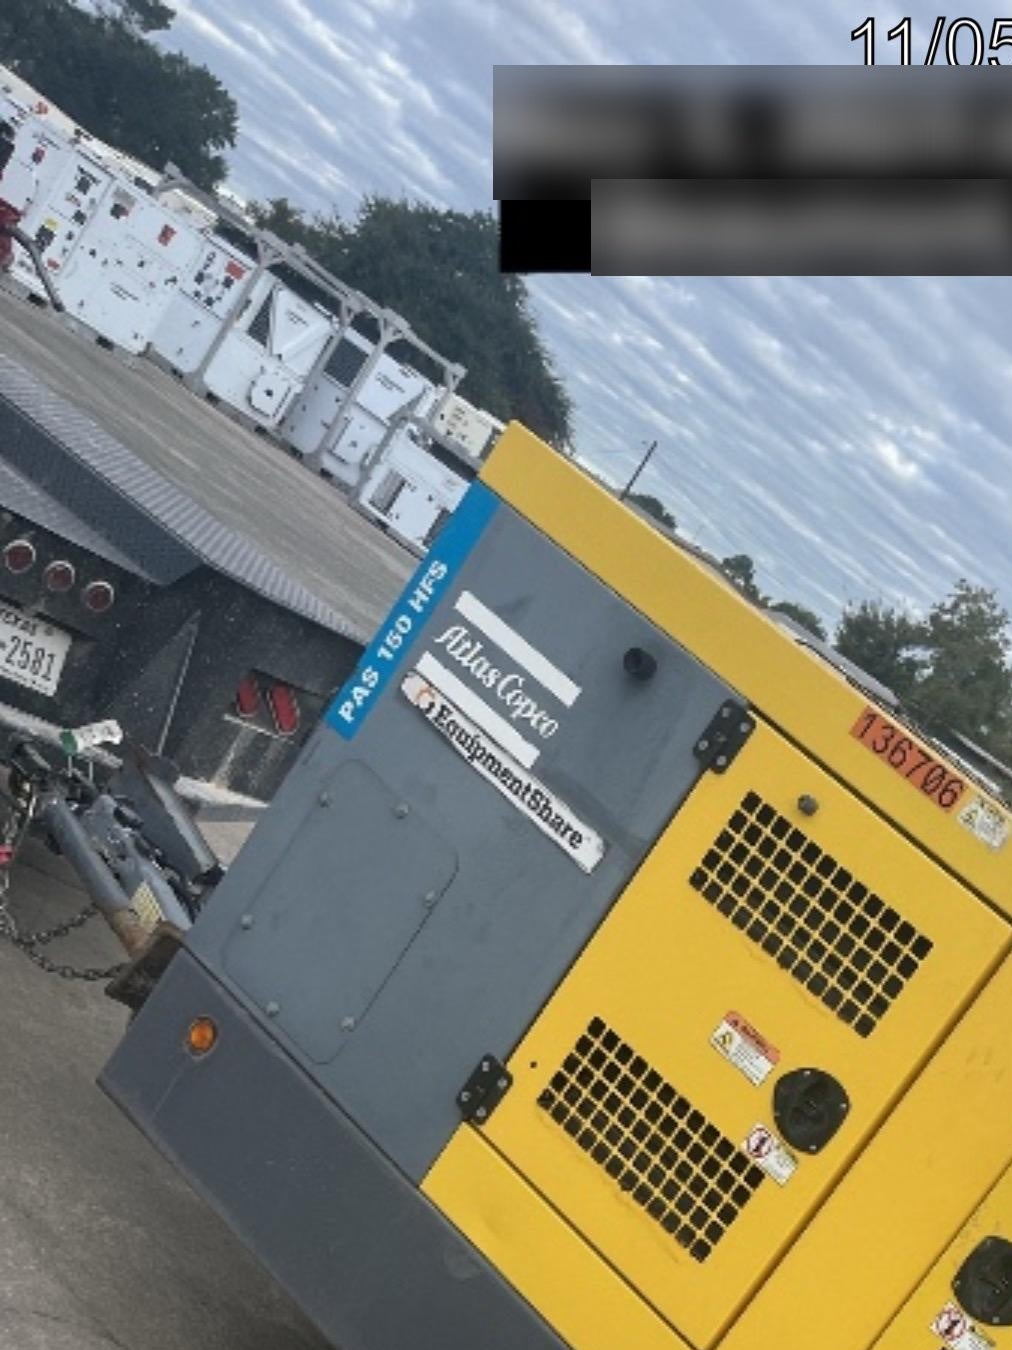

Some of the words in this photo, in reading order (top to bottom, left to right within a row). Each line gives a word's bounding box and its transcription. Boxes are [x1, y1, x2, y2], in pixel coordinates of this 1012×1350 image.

[5, 635, 56, 682] 2581
[337, 666, 380, 723] PAS
[376, 616, 413, 662] 150
[408, 560, 448, 613] HFS
[434, 623, 500, 691] Atlas
[497, 673, 560, 740] Copco
[432, 703, 583, 852] EquipmentShare
[858, 713, 965, 809] 136706
